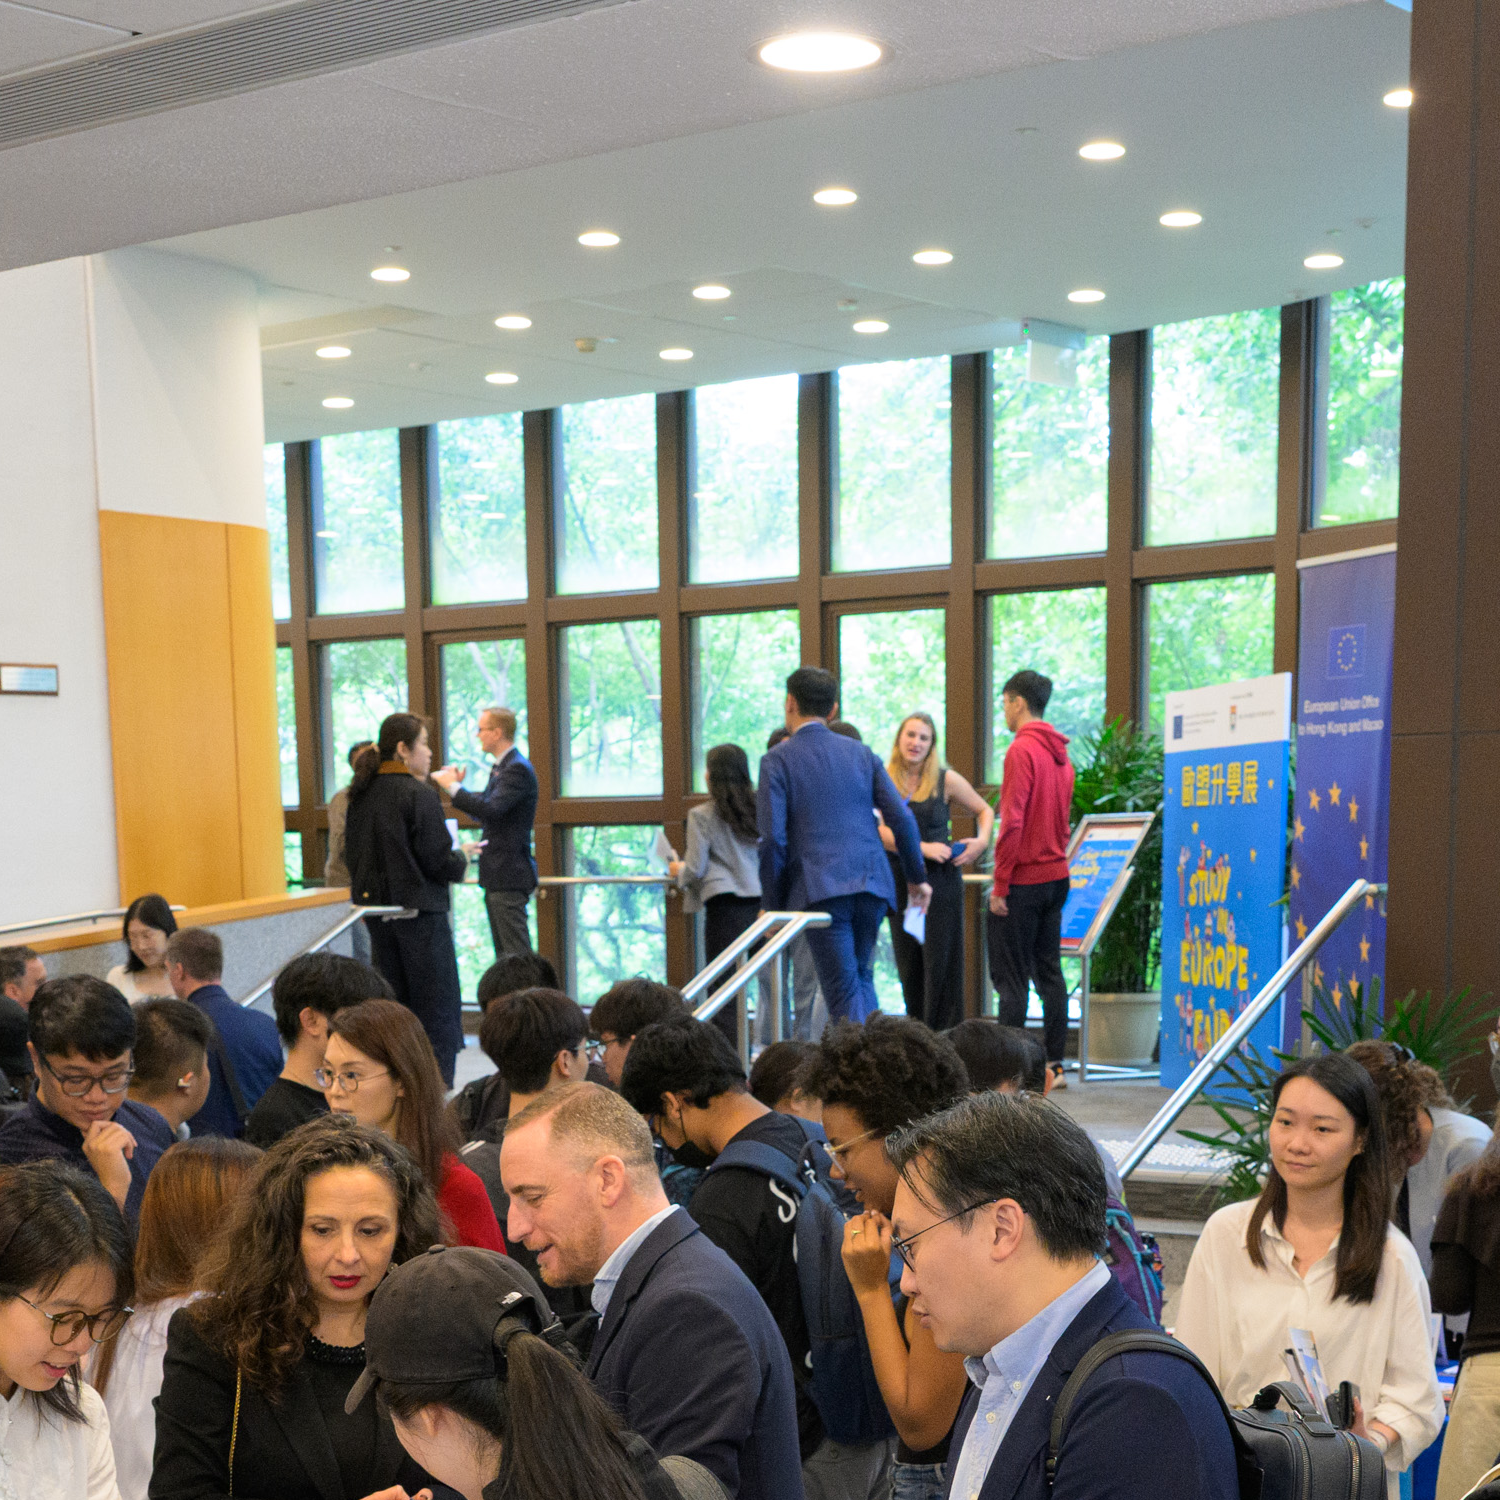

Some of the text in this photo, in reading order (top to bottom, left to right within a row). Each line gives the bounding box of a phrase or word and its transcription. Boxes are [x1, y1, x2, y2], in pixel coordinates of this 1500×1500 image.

[1303, 700, 1340, 716] European
[1340, 697, 1361, 713] Union
[1306, 723, 1327, 738] Hong
[1327, 721, 1348, 737] Kong
[1348, 719, 1361, 733] and
[1187, 865, 1231, 907] STUDY
[1179, 936, 1250, 993] EUROPE
